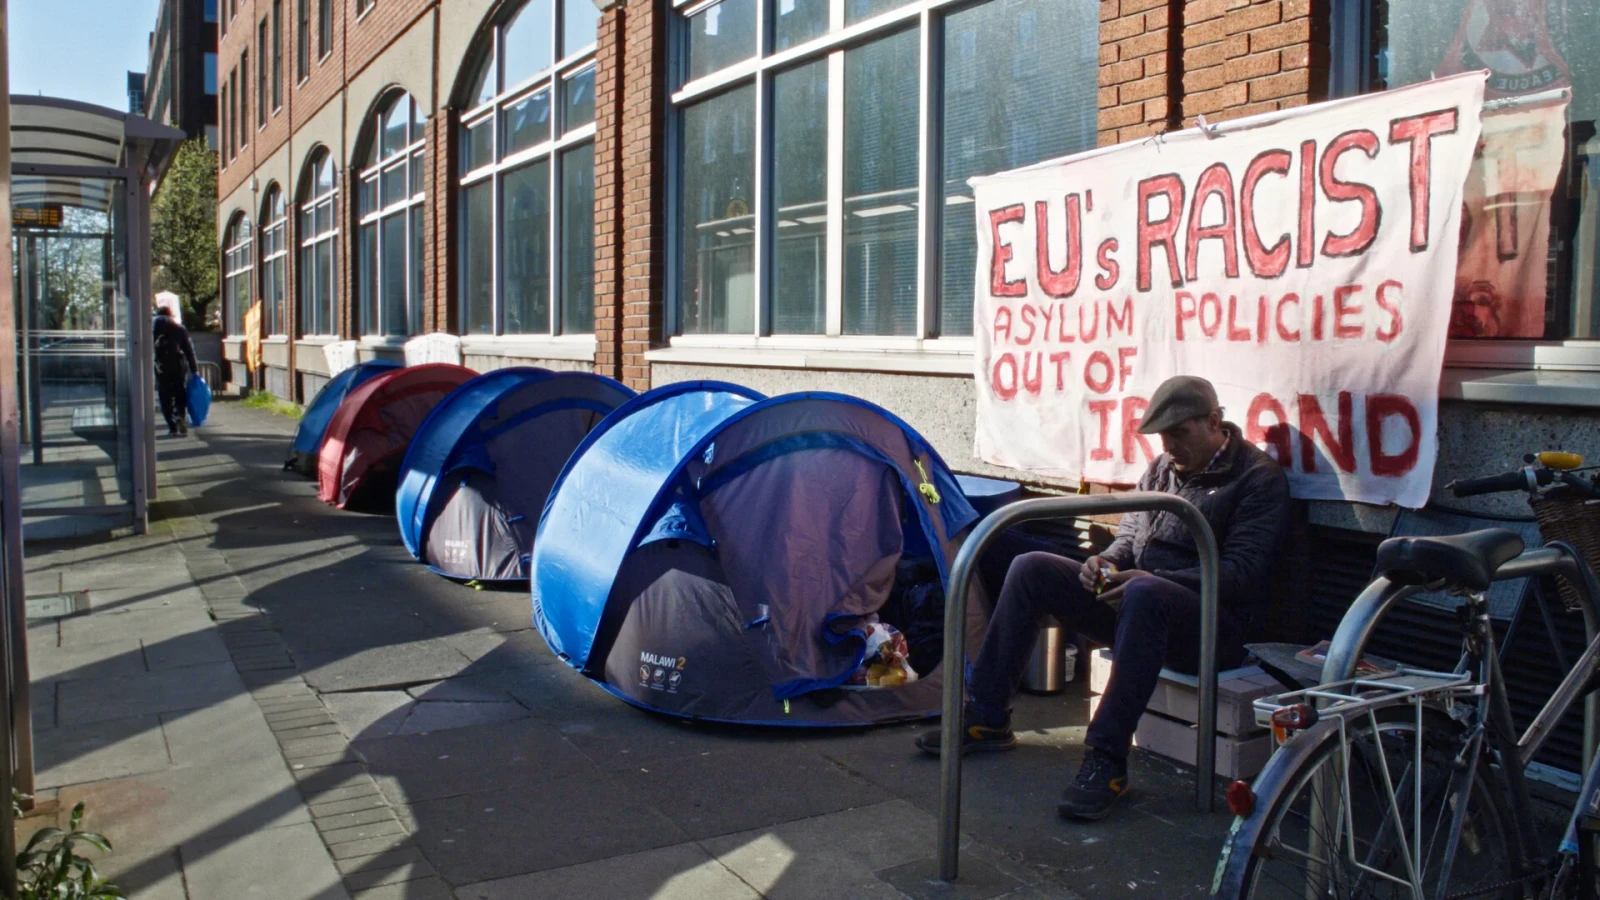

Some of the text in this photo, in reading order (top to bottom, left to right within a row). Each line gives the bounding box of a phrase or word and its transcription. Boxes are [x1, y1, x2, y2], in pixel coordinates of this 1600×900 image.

[989, 189, 1119, 299] EU's
[1136, 107, 1458, 291] RACIST
[993, 280, 1403, 346] ASYLUM POLICIES
[992, 347, 1138, 401] OUT OF
[1089, 391, 1422, 477] IRAND
[640, 651, 686, 671] MALAWI 2
